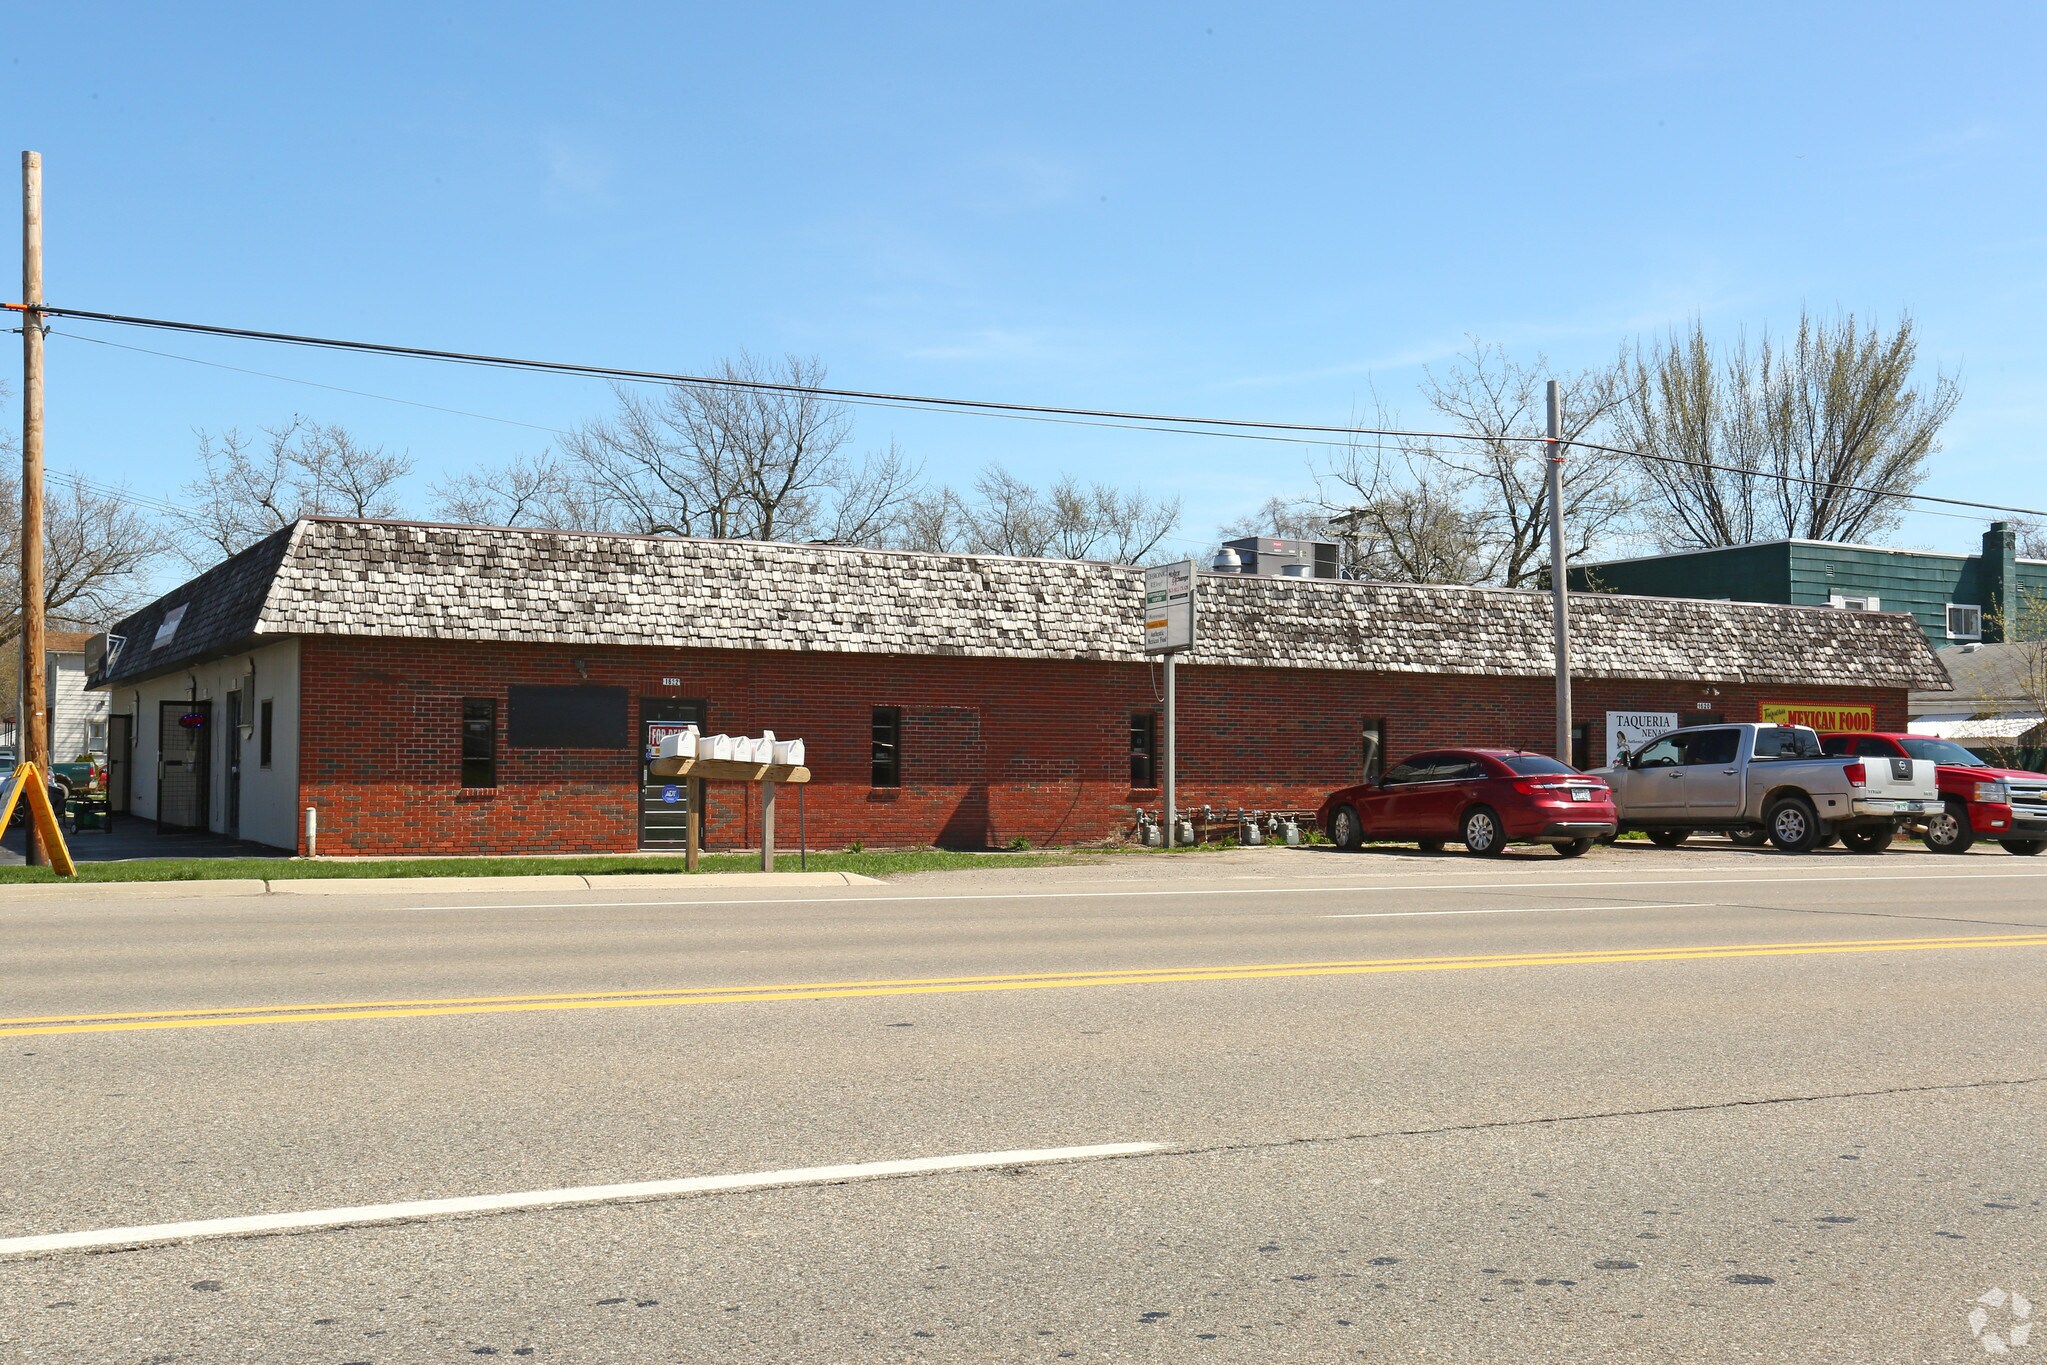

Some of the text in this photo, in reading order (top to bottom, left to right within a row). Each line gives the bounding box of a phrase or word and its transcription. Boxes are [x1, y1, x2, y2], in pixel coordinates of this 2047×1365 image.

[1616, 716, 1670, 729] TAQUERIA
[1788, 710, 1870, 730] MEXICAN FOOD
[652, 728, 666, 744] FOR
